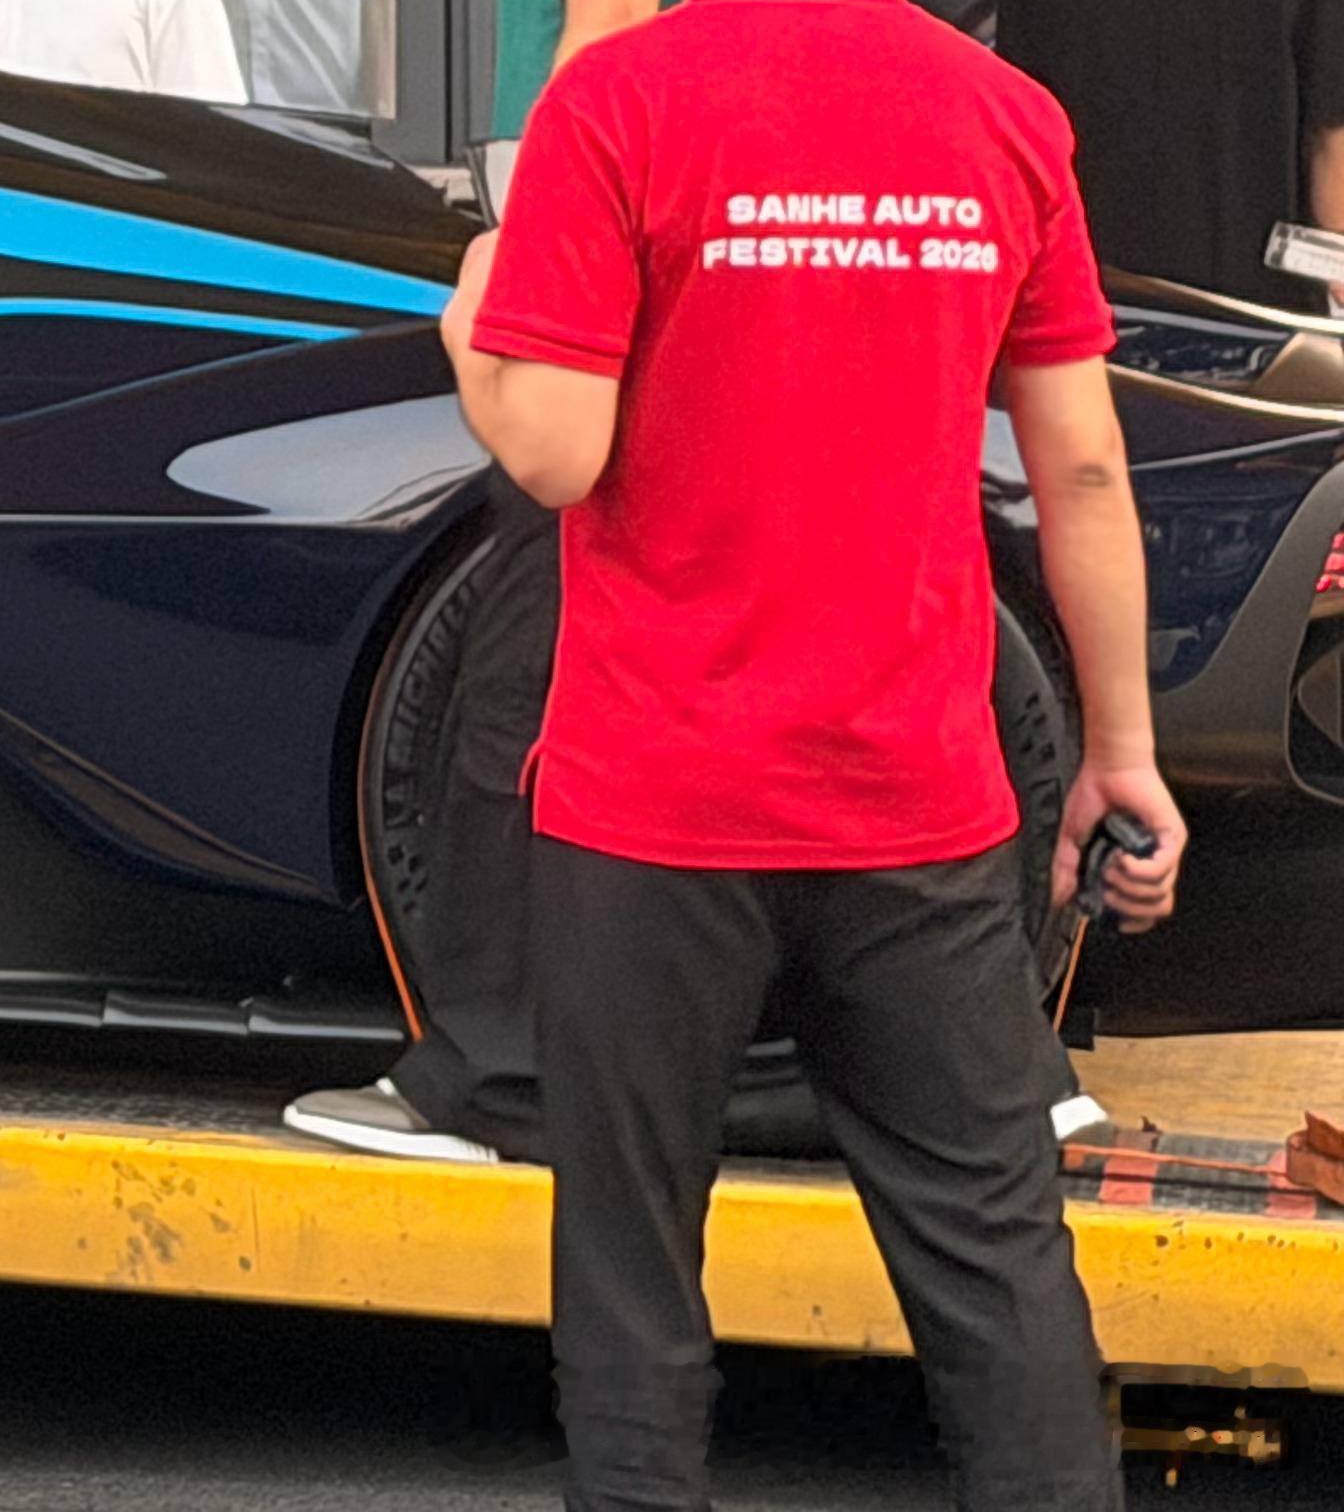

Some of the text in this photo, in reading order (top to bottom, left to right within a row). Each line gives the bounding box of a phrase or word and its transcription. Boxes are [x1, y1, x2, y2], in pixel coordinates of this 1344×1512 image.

[726, 194, 982, 228] SANHE AUTO
[703, 238, 911, 270] FESTIVAL
